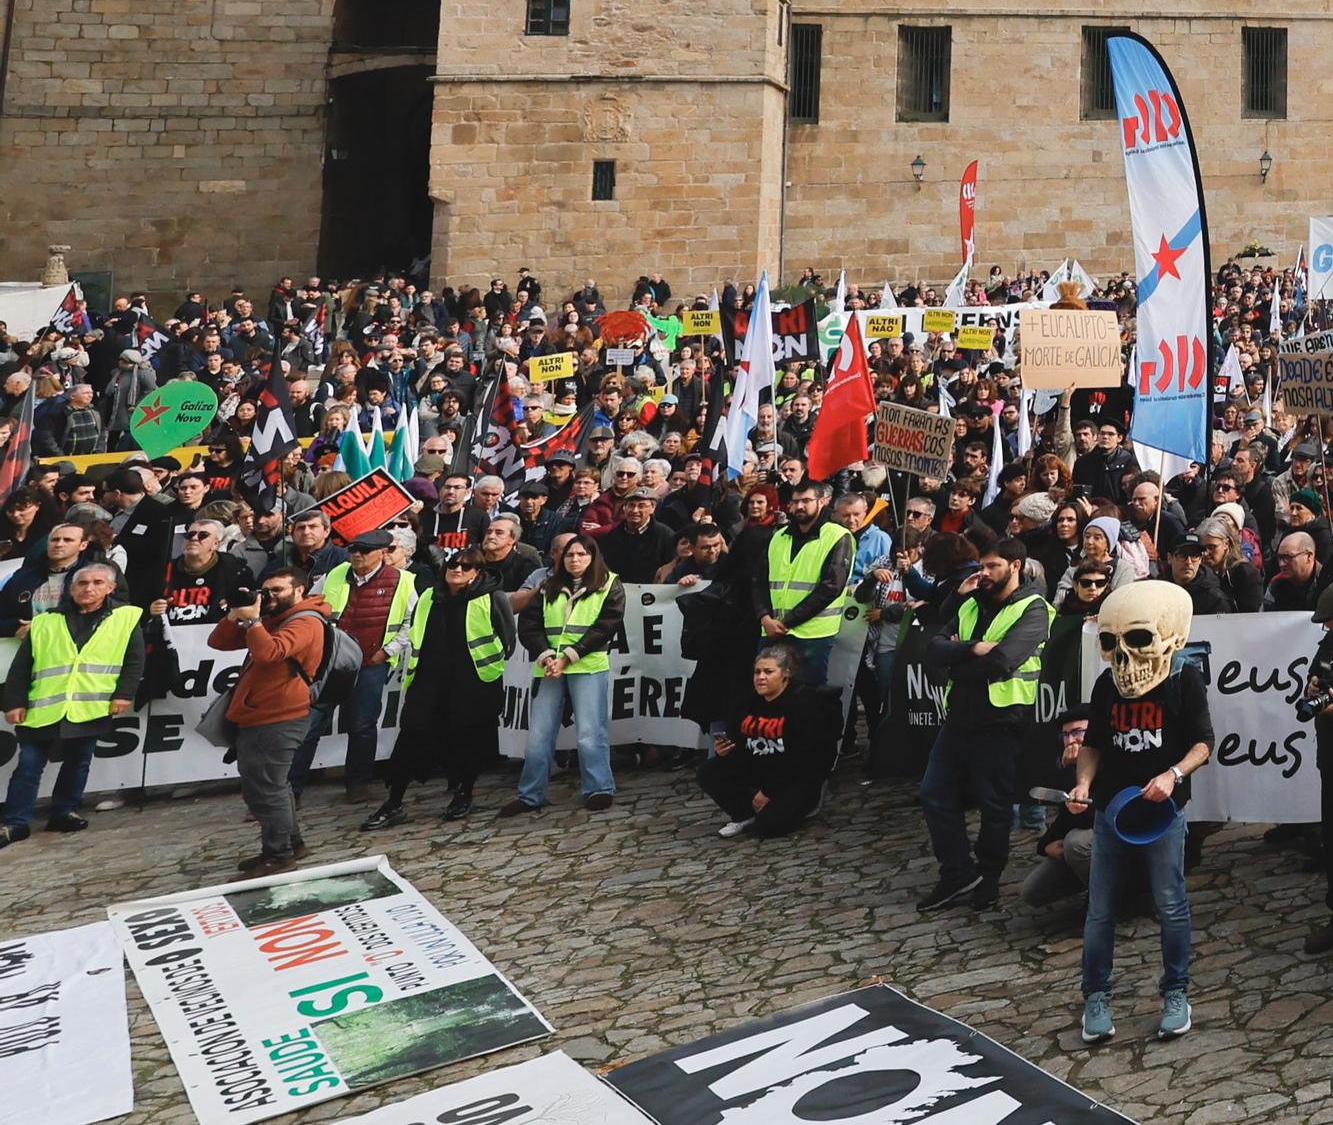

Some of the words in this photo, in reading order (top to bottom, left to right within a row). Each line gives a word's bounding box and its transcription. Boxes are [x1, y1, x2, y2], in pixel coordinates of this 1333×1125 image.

[690, 312, 713, 320] ALTRI
[693, 319, 711, 327] NON
[868, 317, 898, 325] ALTRI
[538, 356, 565, 367] ALTRI
[541, 364, 562, 373] NON
[1025, 347, 1063, 368] MORTE
[1075, 346, 1121, 368] GALICIA
[180, 400, 214, 412] Galiza
[175, 413, 201, 423] Nova
[881, 406, 900, 424] NON
[935, 418, 951, 435] AS
[876, 422, 925, 453] GUERRAS
[923, 435, 946, 456] COS
[874, 446, 902, 467] NOSOS
[904, 451, 947, 475] MONTES
[320, 474, 390, 518] ALQUILA
[741, 715, 784, 738] ALTRI
[123, 907, 196, 952] SEXO
[248, 912, 349, 972] NON
[287, 971, 384, 1018] SI
[261, 1027, 340, 1098] SAUDE
